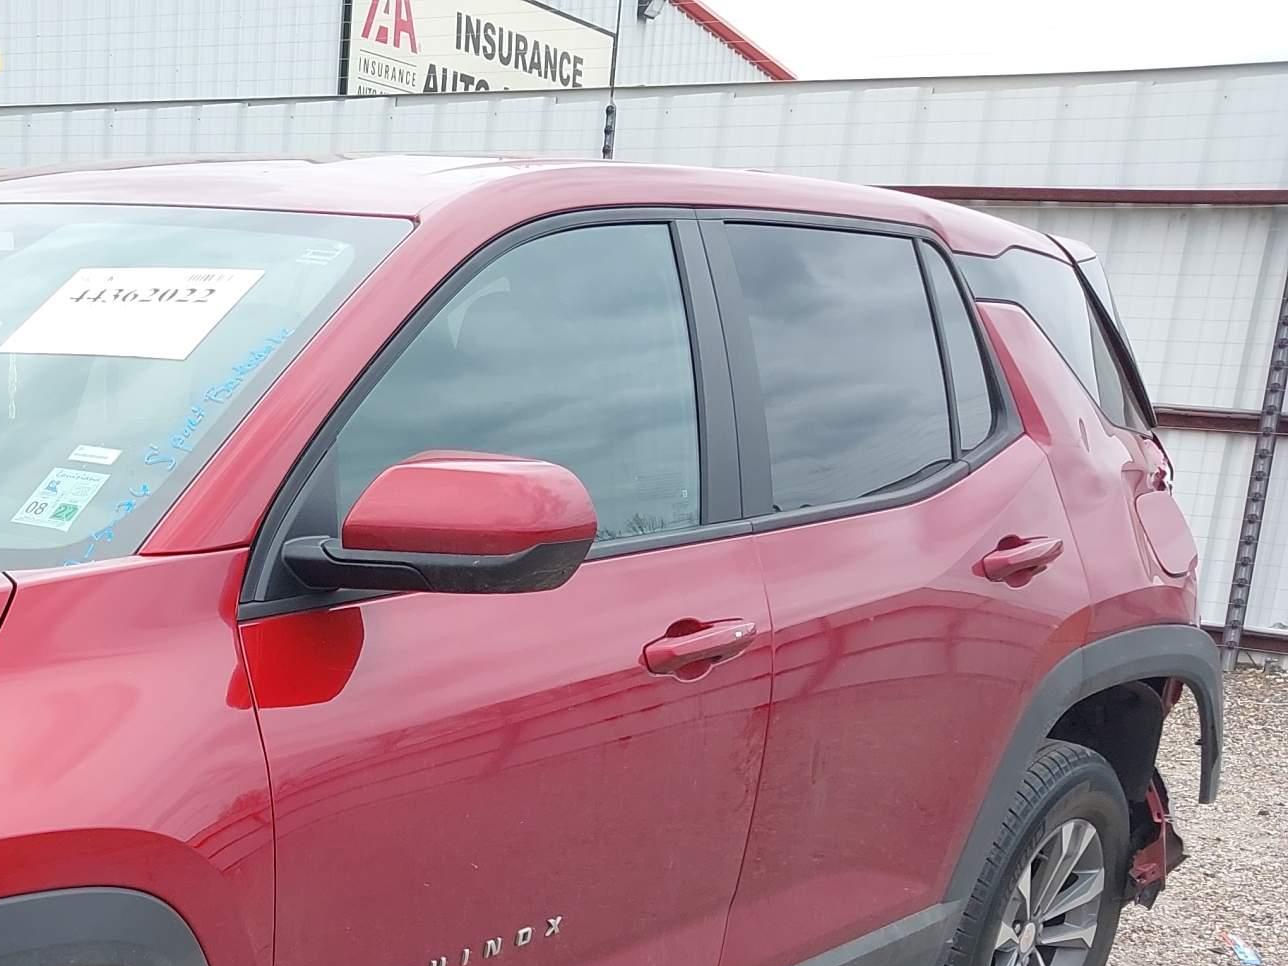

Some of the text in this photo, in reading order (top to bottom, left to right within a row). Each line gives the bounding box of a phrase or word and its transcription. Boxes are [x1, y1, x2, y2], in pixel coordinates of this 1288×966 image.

[455, 11, 584, 88] INSURANCE
[357, 56, 417, 87] INSURANCE
[69, 287, 216, 304] 44362022
[24, 500, 78, 519] 08 27
